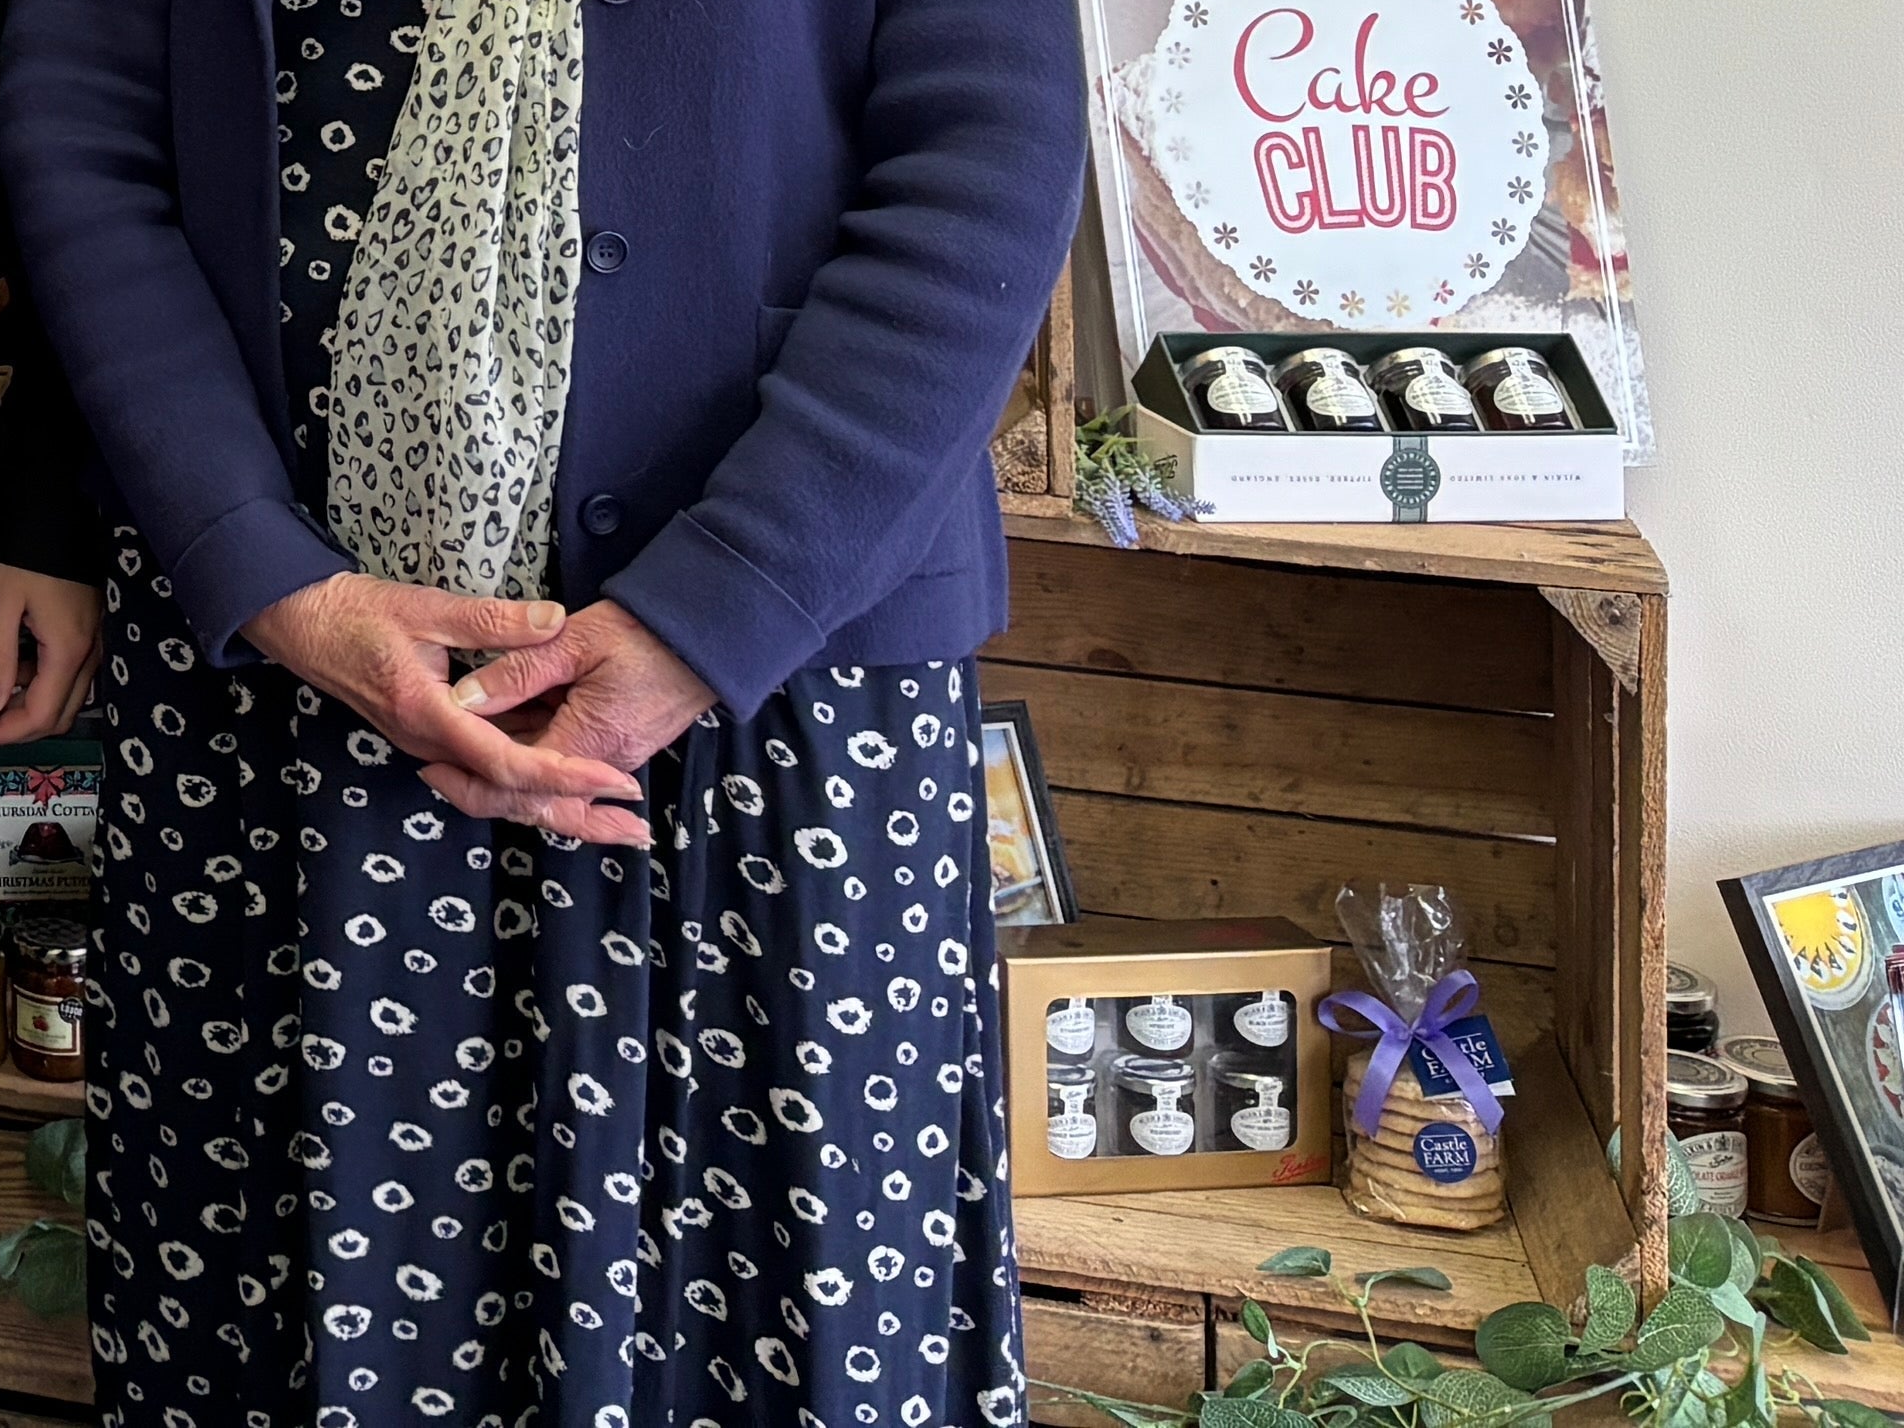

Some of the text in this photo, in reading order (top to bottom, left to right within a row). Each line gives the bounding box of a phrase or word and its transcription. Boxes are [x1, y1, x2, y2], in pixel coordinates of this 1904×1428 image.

[1232, 6, 1451, 123] Cake
[1253, 125, 1457, 234] CLUB
[51, 803, 96, 817] COTTA
[1421, 1036, 1487, 1061] Ctle
[1426, 1051, 1493, 1076] FM
[1420, 1134, 1468, 1152] Castle
[1423, 1149, 1470, 1165] FARM
